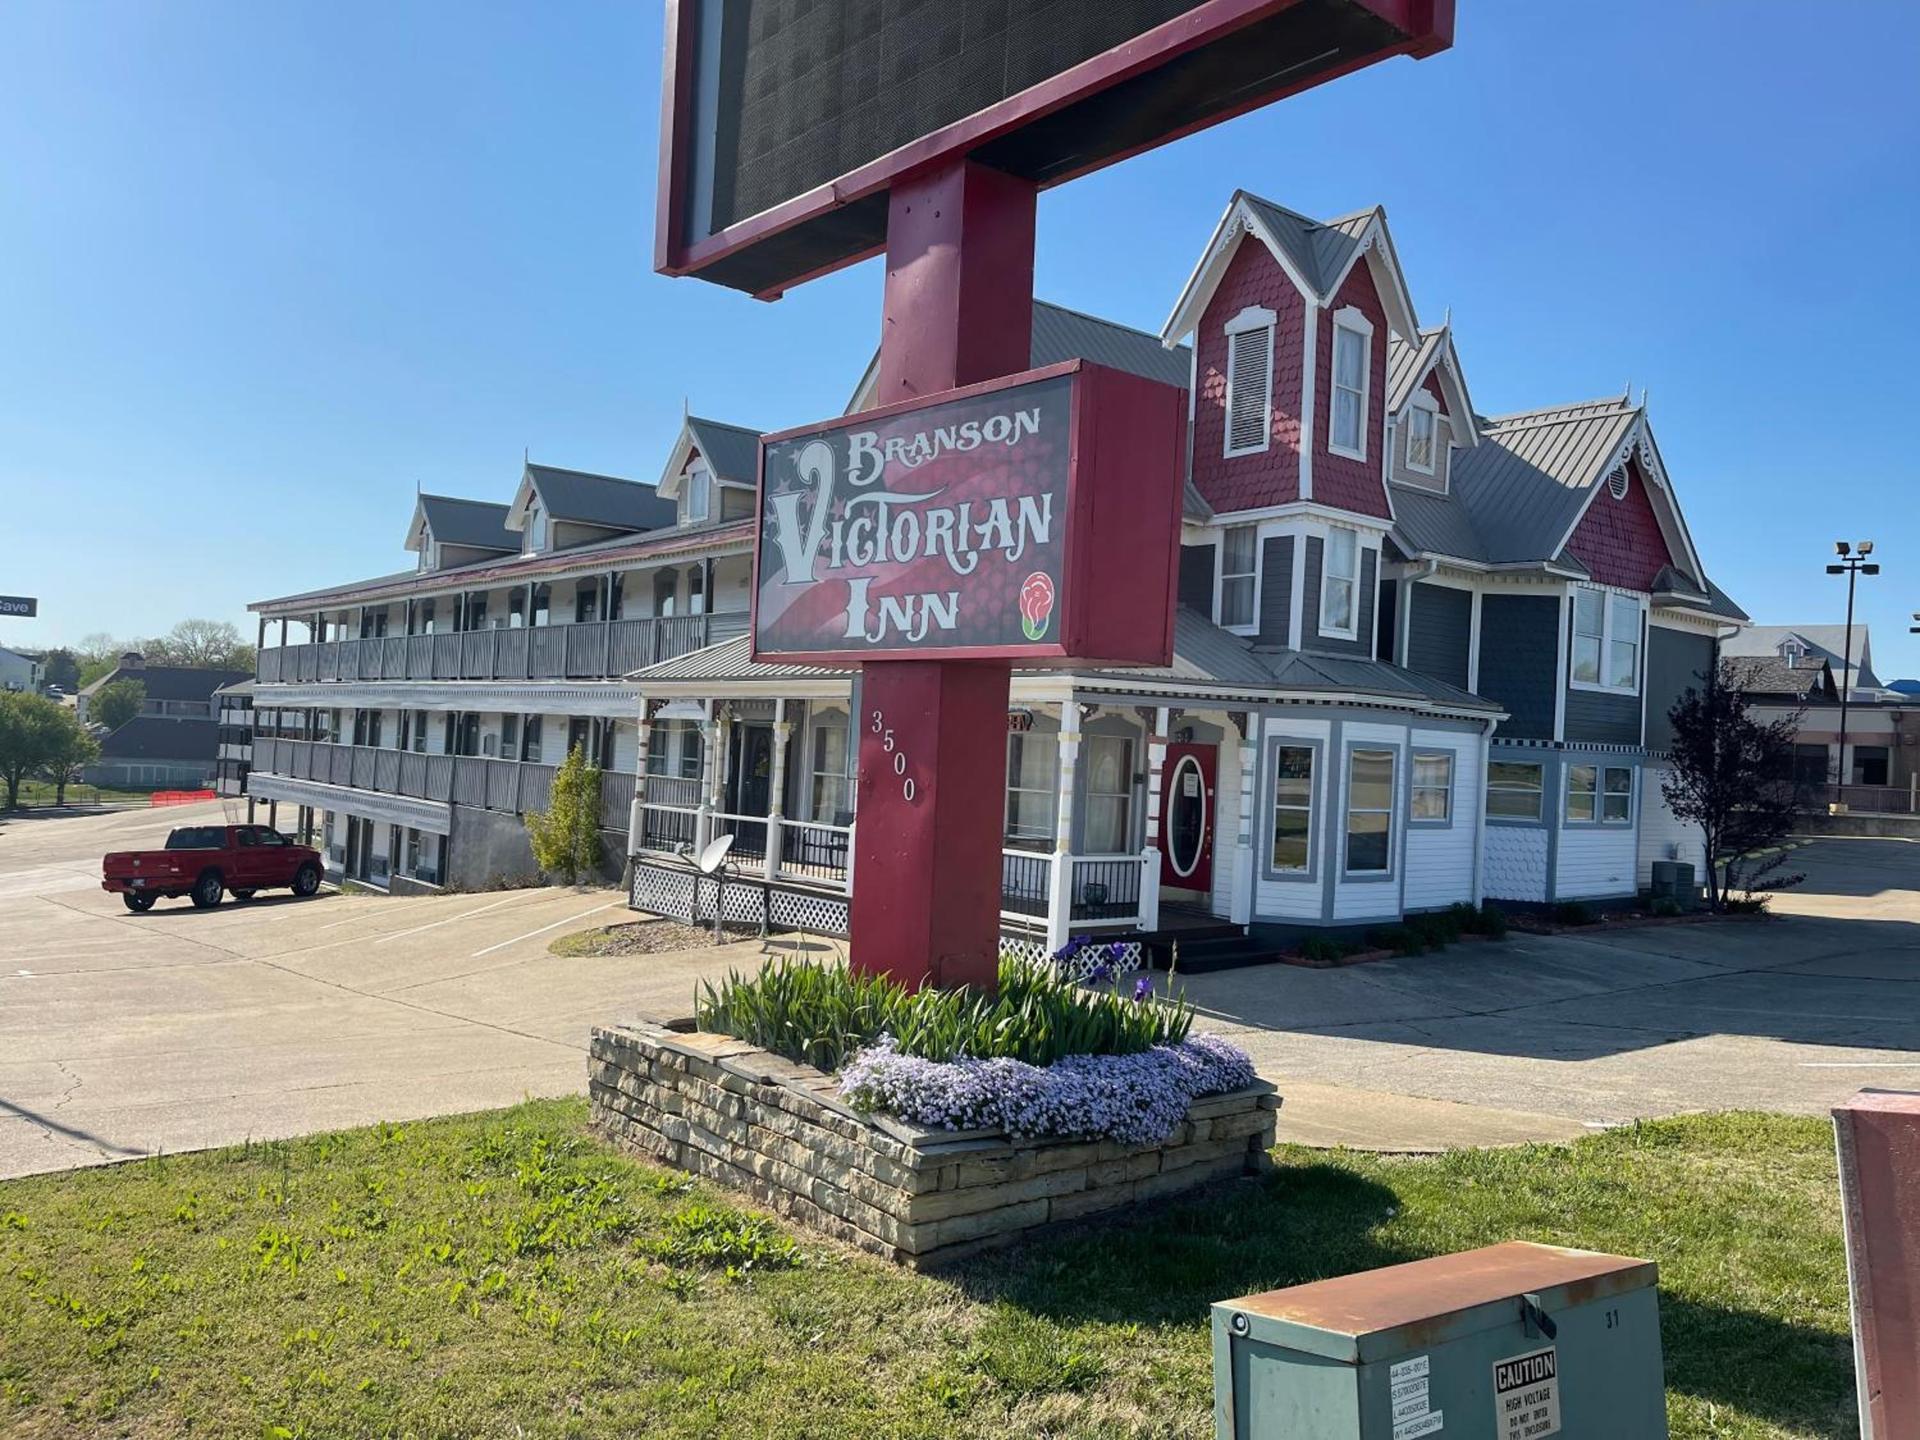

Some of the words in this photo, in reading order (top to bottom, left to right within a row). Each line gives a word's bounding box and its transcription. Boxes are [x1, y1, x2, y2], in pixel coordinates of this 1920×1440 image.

[843, 408, 1041, 486] BRANSON
[769, 440, 1053, 585] VICTORIAN
[0, 601, 28, 613] ave
[843, 577, 959, 643] INN
[872, 711, 915, 801] 3500
[1606, 1310, 1618, 1329] 31
[1498, 1354, 1554, 1390] CAUTION
[1506, 1396, 1522, 1412] HIGH
[1524, 1387, 1551, 1406] VOLTAGE
[1510, 1416, 1518, 1427] DO
[1519, 1413, 1529, 1424] NOT
[1533, 1407, 1548, 1420] ENTER
[1524, 1420, 1551, 1436] ENCLOSURE
